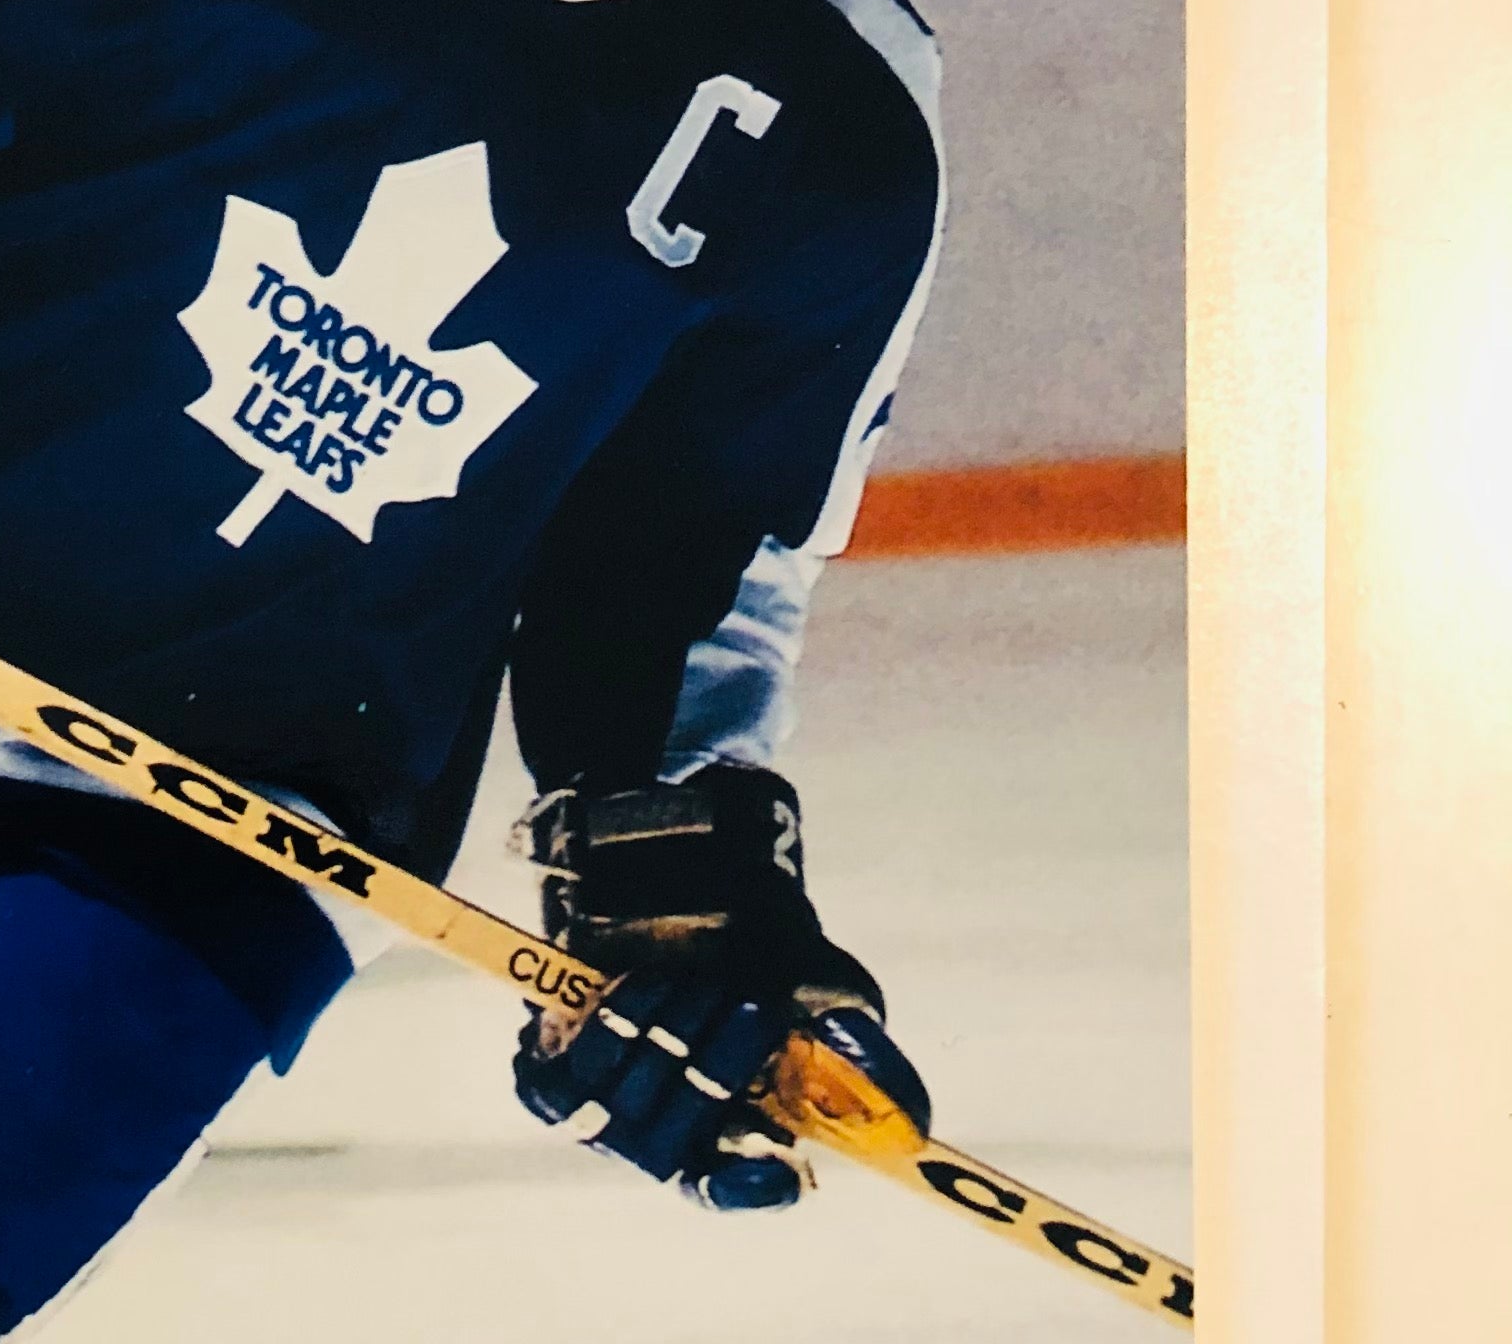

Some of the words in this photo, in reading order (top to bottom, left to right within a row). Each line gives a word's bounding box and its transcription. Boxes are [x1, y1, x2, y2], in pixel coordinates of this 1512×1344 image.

[626, 73, 782, 267] C
[248, 262, 464, 425] TORONTO
[249, 334, 403, 455] MAPLE
[232, 382, 365, 493] LEAFS
[36, 704, 377, 898] CCM
[507, 948, 606, 1008] CUS
